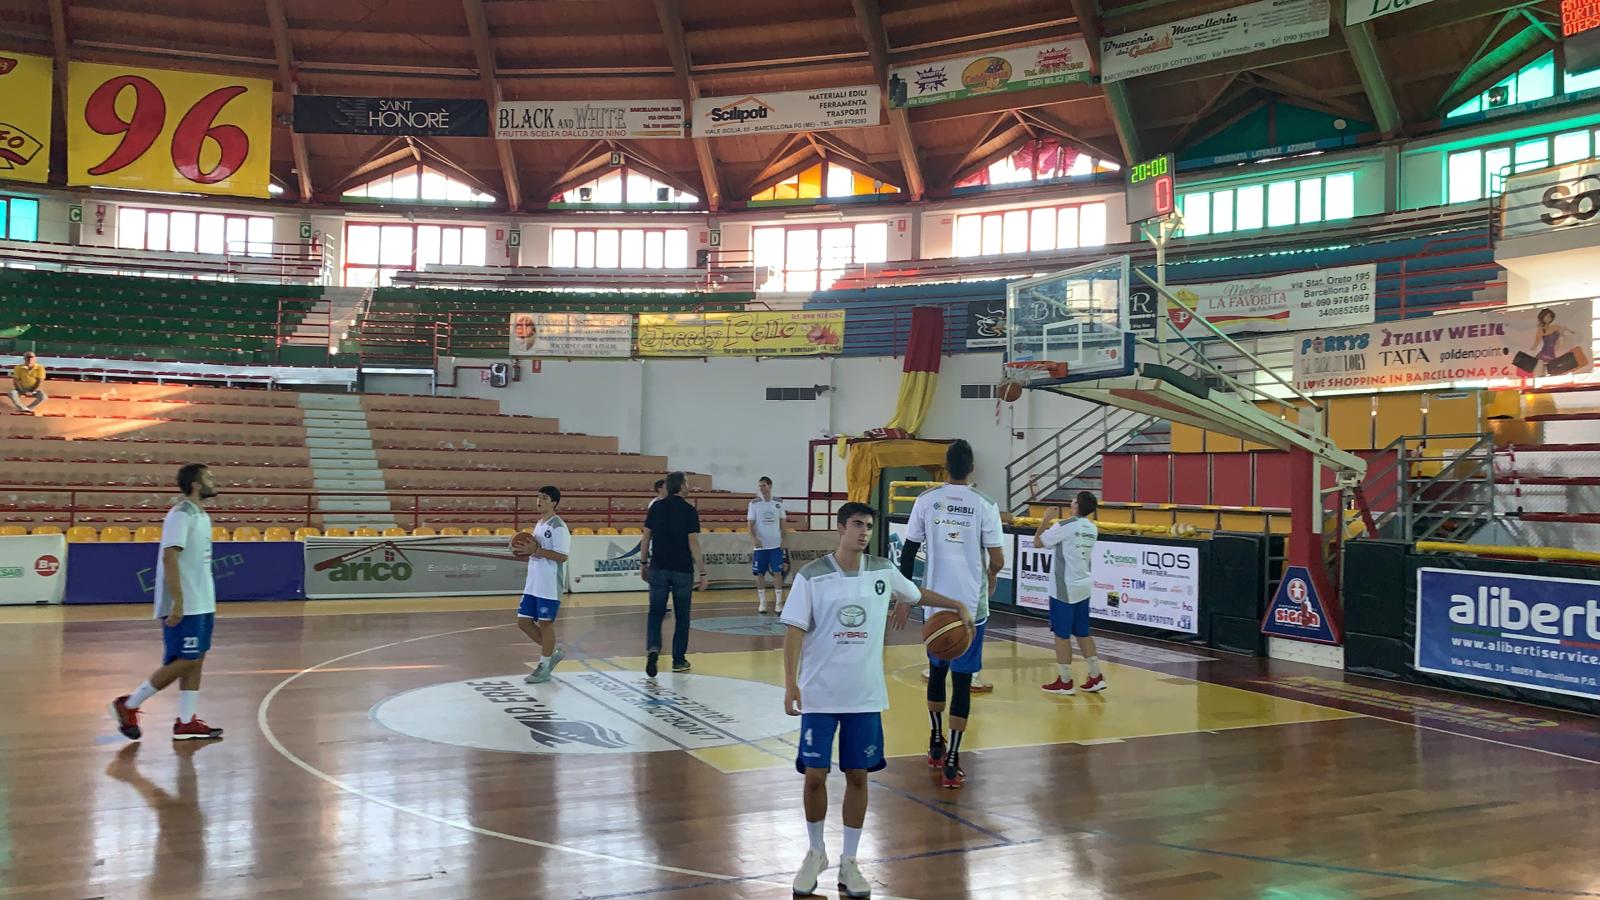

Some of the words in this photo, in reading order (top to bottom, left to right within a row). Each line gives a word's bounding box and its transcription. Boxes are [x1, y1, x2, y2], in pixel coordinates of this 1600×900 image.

[808, 90, 847, 101] MATERIALI
[848, 89, 868, 98] EDILI
[379, 100, 412, 111] SAINT
[819, 99, 868, 109] FERRAMENTA
[369, 108, 450, 128] HONORÈ
[499, 108, 555, 129] BLACK
[558, 119, 574, 129] AND
[573, 104, 627, 130] WHITE
[826, 108, 867, 118] TRASPORTI
[84, 74, 249, 184] 96
[590, 129, 604, 137] ZIO
[606, 129, 627, 137] NINO
[754, 124, 793, 132] BARCELLONA
[1131, 155, 1168, 184] 20:00
[1155, 175, 1172, 213] 0
[70, 207, 81, 221] C
[301, 225, 310, 238] C
[511, 233, 519, 245] D
[711, 232, 719, 245] D
[1291, 281, 1303, 289] via
[1355, 271, 1371, 281] 195
[1303, 286, 1350, 298] Barcellona
[1352, 282, 1369, 292] P.G.
[1208, 297, 1226, 310] LA
[1228, 292, 1287, 308] FAVORITA
[1316, 298, 1331, 307] 090
[725, 313, 798, 347] Pollo
[1393, 328, 1443, 346] TALLY
[1378, 347, 1430, 366] TATA
[1440, 347, 1502, 363] goldenpoint
[1328, 375, 1386, 387] SHOPPING
[1390, 373, 1403, 383] IN
[1406, 367, 1486, 382] BARCELLONA
[946, 504, 974, 515] GHIBLI
[1142, 551, 1190, 569] IQOS
[328, 557, 413, 582] arico
[1142, 569, 1168, 577] PARTNER
[1131, 578, 1146, 590] TIM
[833, 631, 868, 639] HYBRID
[804, 728, 813, 746] 4
